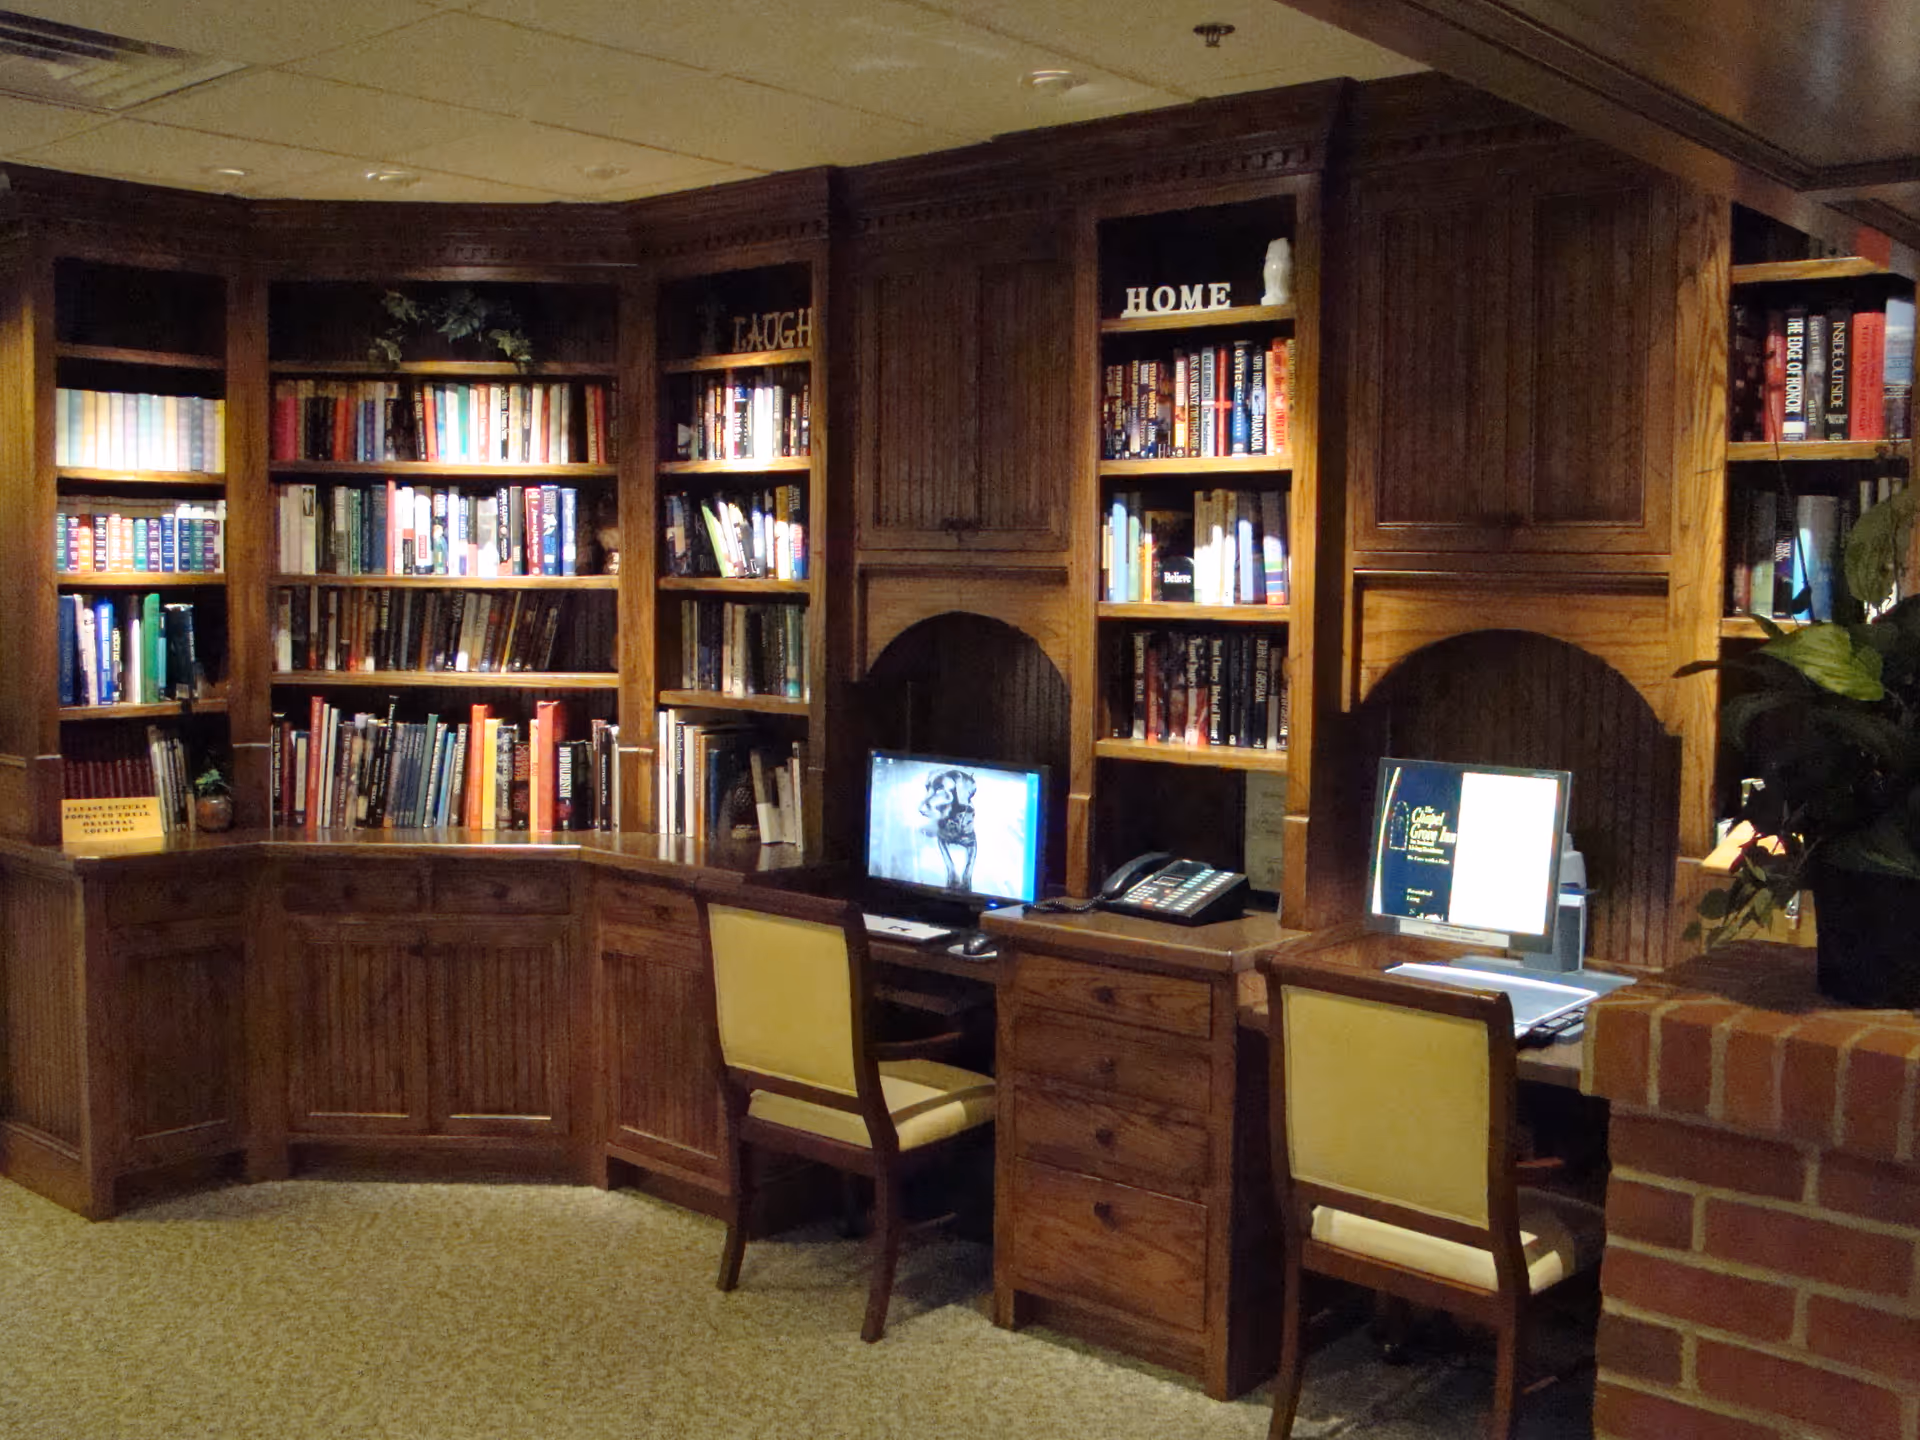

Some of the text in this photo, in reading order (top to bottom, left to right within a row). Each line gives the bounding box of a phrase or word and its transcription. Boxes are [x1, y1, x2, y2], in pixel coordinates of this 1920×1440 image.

[1126, 283, 1231, 313] HOME
[733, 307, 812, 352] LAUGH
[1148, 363, 1157, 390] STUART
[1785, 317, 1803, 413] THE EDGE OF HONOR
[1148, 391, 1157, 419] WOODS
[1251, 415, 1263, 450] PARANOIA
[1164, 571, 1191, 583] Believe
[1211, 657, 1222, 682] Clancy
[1255, 639, 1268, 702] JOHN GRISHAM
[559, 763, 572, 798] HALBERSTAM
[108, 803, 148, 811] RETURN
[1411, 807, 1445, 829] Chapel
[1439, 826, 1457, 844] Inn
